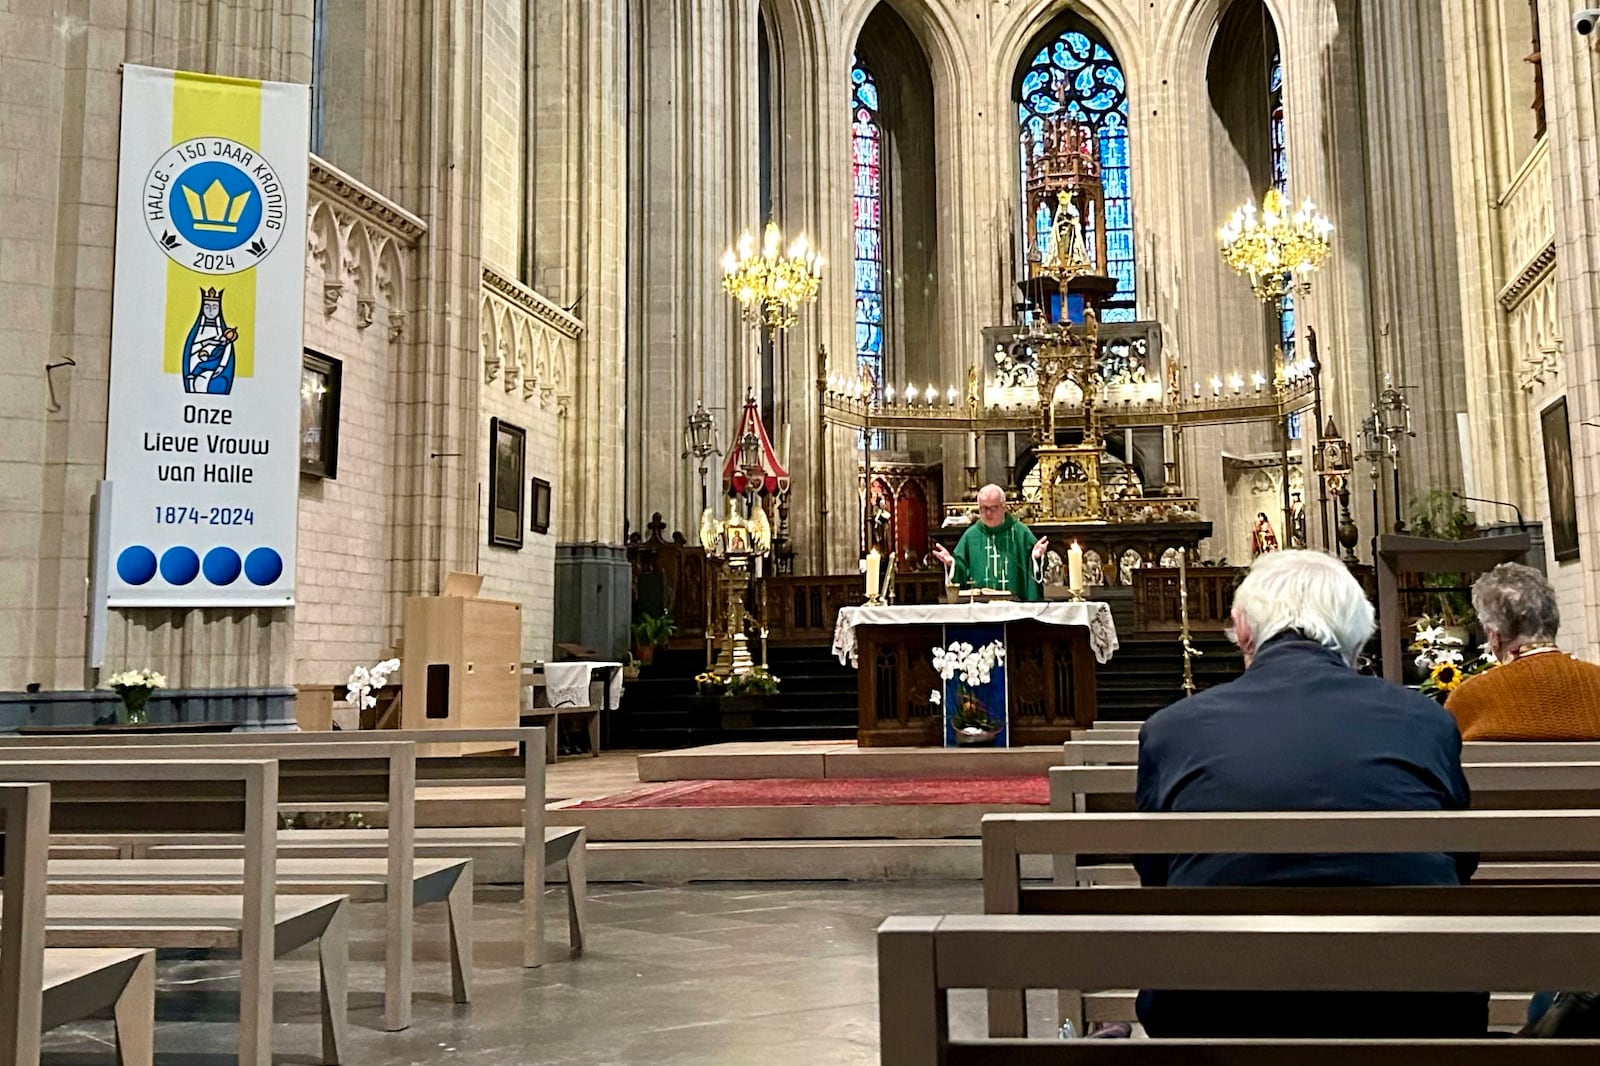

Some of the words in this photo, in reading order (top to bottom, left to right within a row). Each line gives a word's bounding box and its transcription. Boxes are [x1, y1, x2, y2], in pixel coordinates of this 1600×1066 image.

[148, 170, 170, 221] HALLE
[177, 142, 207, 163] 150
[213, 142, 253, 168] JAAR
[253, 163, 283, 230] KRONING
[193, 252, 235, 271] 2024
[183, 405, 232, 425] Onze
[144, 432, 198, 453] Lieve
[207, 434, 269, 455] Vrouw
[158, 465, 195, 482] van
[204, 464, 253, 483] Halle
[156, 506, 254, 526] 1874-2024
